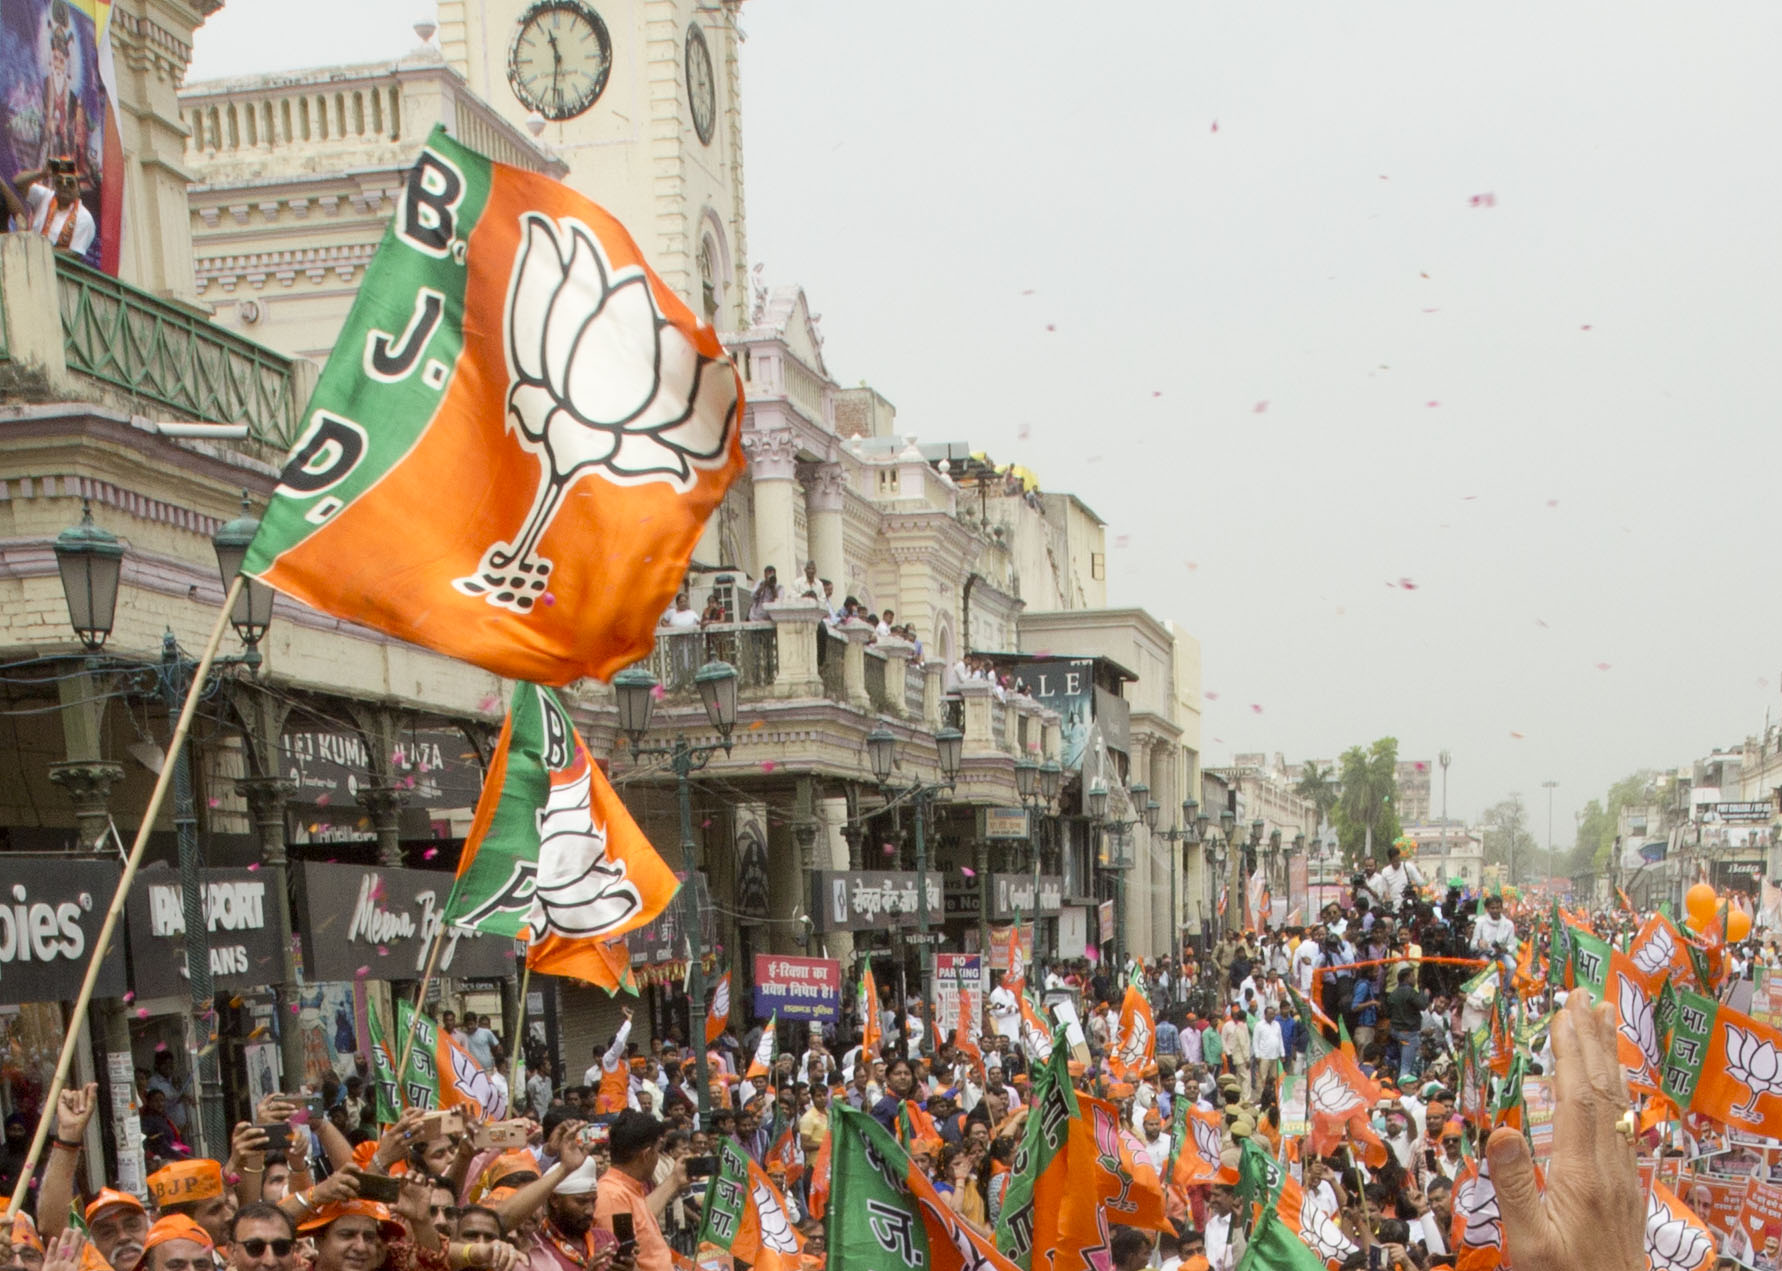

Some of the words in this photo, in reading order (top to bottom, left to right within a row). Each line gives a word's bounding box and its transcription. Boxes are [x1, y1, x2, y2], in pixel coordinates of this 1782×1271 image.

[363, 287, 445, 391] J.
[952, 955, 966, 967] NO
[762, 980, 787, 996] प्रवेश
[1681, 1004, 1708, 1036] भा.
[1675, 1036, 1701, 1067] ज.
[1665, 1064, 1693, 1097] पा.
[155, 1176, 199, 1199] BJP
[708, 1206, 734, 1241] पा.
[866, 1197, 924, 1268] ज.
